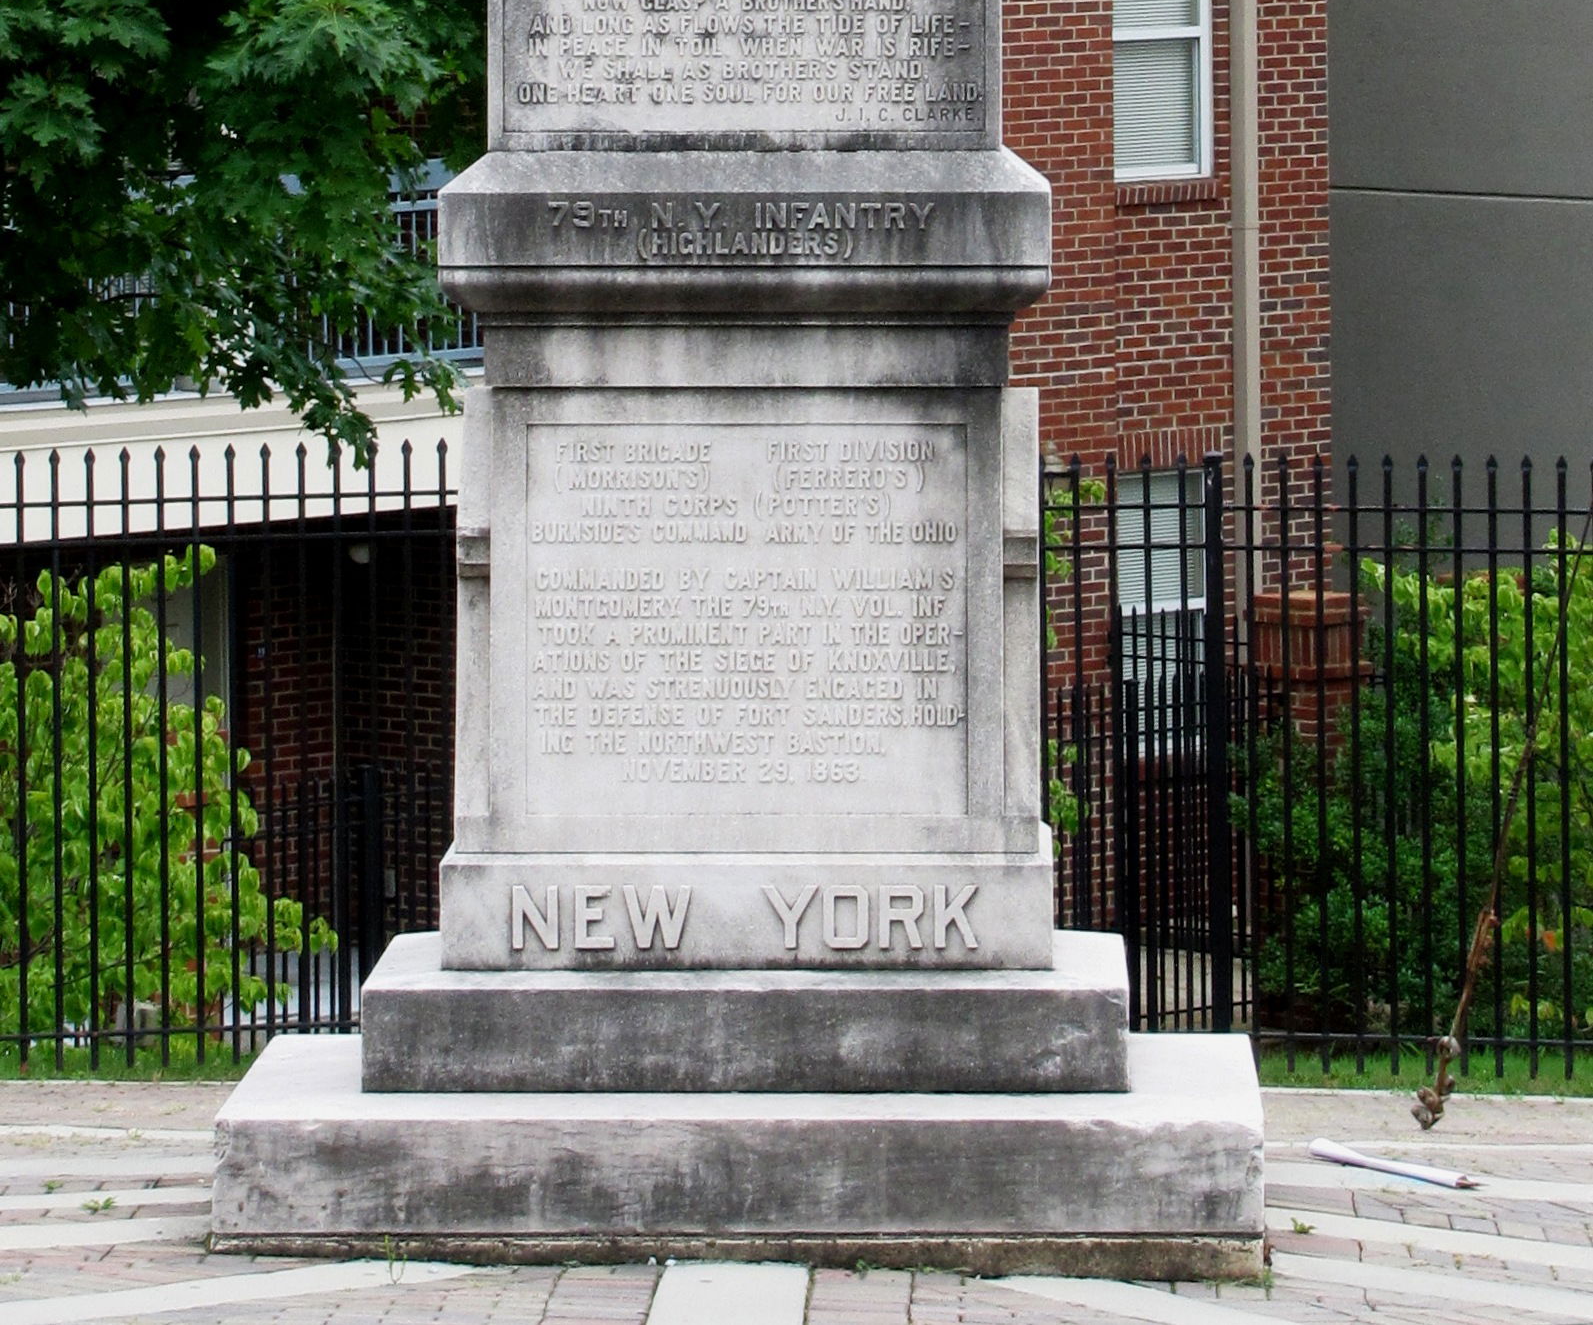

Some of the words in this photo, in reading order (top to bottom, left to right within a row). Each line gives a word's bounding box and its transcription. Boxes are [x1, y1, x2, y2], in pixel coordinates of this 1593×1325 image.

[530, 15, 571, 34] AND
[582, 15, 633, 34] LONG
[642, 15, 669, 34] AS
[680, 15, 754, 34] FLOWS
[764, 15, 804, 34] THE
[816, 15, 864, 34] TIDE
[876, 15, 902, 34] OF
[528, 38, 548, 57] IN
[642, 38, 662, 57] IN
[740, 38, 801, 57] WHEN
[816, 38, 864, 57] WAR
[876, 38, 895, 57] IS
[559, 61, 593, 81] WE
[603, 61, 673, 81] SHALL
[682, 61, 710, 81] AS
[722, 61, 836, 81] BROTHERS
[518, 83, 557, 103] ONE
[567, 83, 641, 103] HEART
[651, 83, 694, 103] ONE
[702, 83, 753, 103] SOUL
[763, 83, 801, 103] FOR
[813, 83, 853, 103] OUR
[864, 83, 915, 103] FREE
[902, 107, 982, 122] CLARKE.
[755, 201, 935, 229] INFANTRY
[637, 227, 854, 259] (HIGHLANDERS)
[556, 441, 614, 463] FIRST
[625, 441, 711, 463] BRIGADE
[767, 441, 828, 463] FIRST
[840, 441, 936, 463] DIVISION
[582, 495, 651, 517] NINTH
[664, 495, 738, 517] CORPS
[652, 522, 748, 544] COMMAND
[766, 522, 821, 544] ARMY
[832, 522, 856, 544] OF
[868, 522, 903, 544] THE
[911, 522, 958, 544] OHIO
[535, 568, 665, 591] COMMANDED
[679, 568, 710, 591] BY
[724, 568, 817, 591] CAPTAIN
[691, 595, 733, 619] THE
[538, 624, 595, 647] TOOK
[606, 624, 620, 647] A
[629, 624, 748, 647] PROMINENT
[759, 624, 811, 647] PART
[823, 624, 841, 647] IN
[851, 624, 890, 647] THE
[900, 624, 963, 647] OPER-
[532, 650, 611, 673] ATIONS
[621, 650, 647, 673] OF
[660, 650, 703, 673] THE
[714, 650, 776, 673] SIEGE
[787, 650, 815, 673] OF
[532, 677, 577, 700] AND
[585, 677, 636, 700] WAS
[646, 677, 795, 700] STRENUOUSLY
[805, 677, 903, 700] ENGAGED
[917, 677, 938, 700] IN
[535, 704, 577, 727] THE
[590, 704, 685, 727] DEFENSE
[696, 704, 723, 727] OF
[737, 704, 789, 727] FORT
[541, 731, 574, 755] ING
[586, 731, 627, 755] THE
[638, 731, 774, 755] NORTHWEST
[622, 759, 747, 783] NOVEMBER
[510, 884, 692, 950] NEW
[760, 884, 980, 950] YORK
